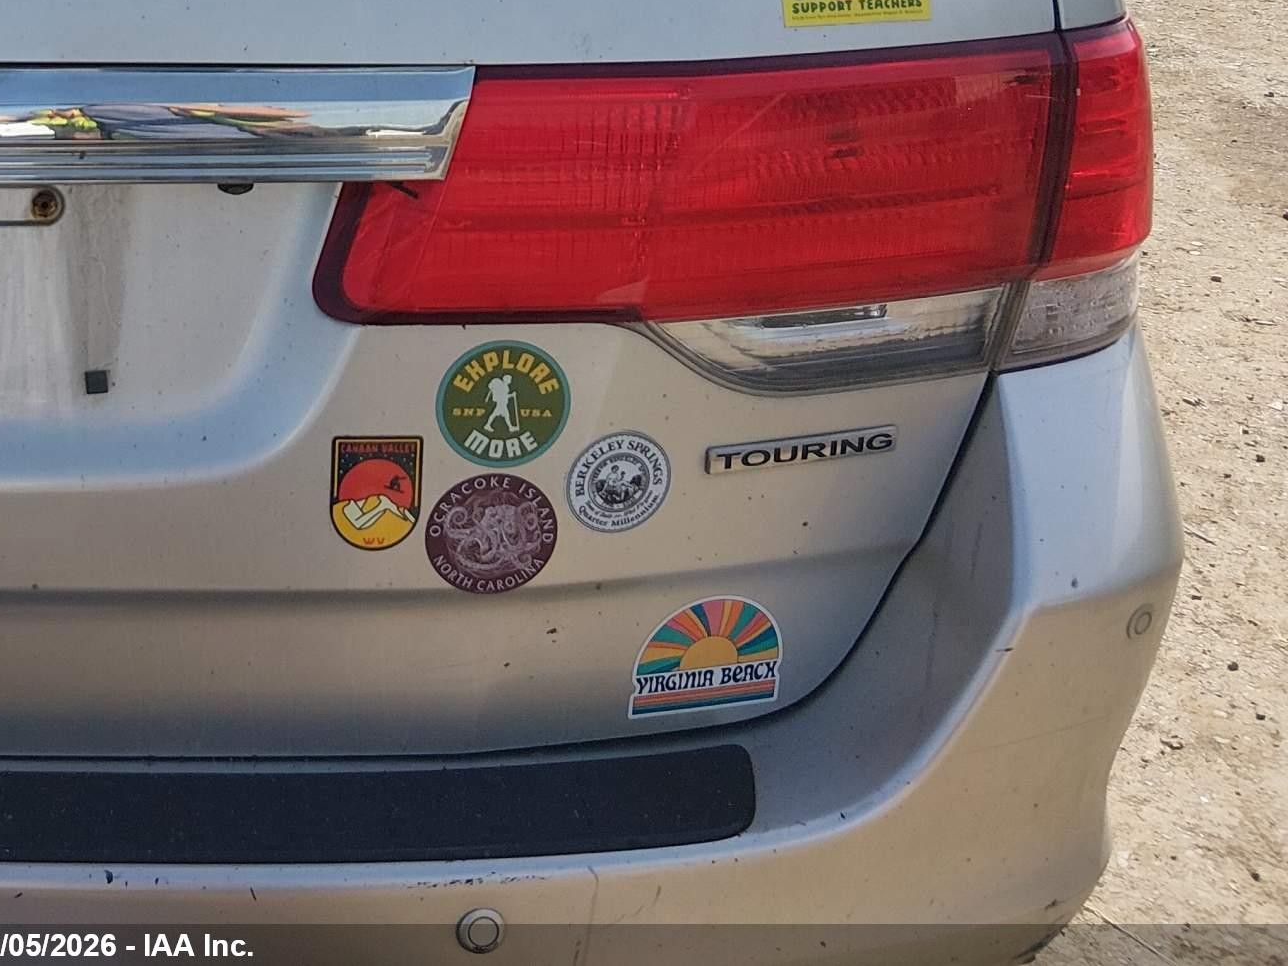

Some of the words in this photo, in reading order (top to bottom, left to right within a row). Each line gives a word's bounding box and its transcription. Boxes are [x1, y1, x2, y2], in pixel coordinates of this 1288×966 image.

[791, 0, 853, 15] SUPPORT
[452, 349, 560, 395] EXPLORE
[520, 408, 553, 419] USA
[463, 429, 538, 458] MORE
[717, 433, 894, 470] TOURING
[575, 439, 625, 498] BERKELEY
[626, 439, 664, 486] SPRINGS
[429, 476, 512, 537] OCRACOKE
[518, 482, 554, 544] ISLAND
[433, 554, 473, 589] NORTH
[476, 557, 545, 592] CAROLINA
[636, 670, 715, 696] VIRGINIA
